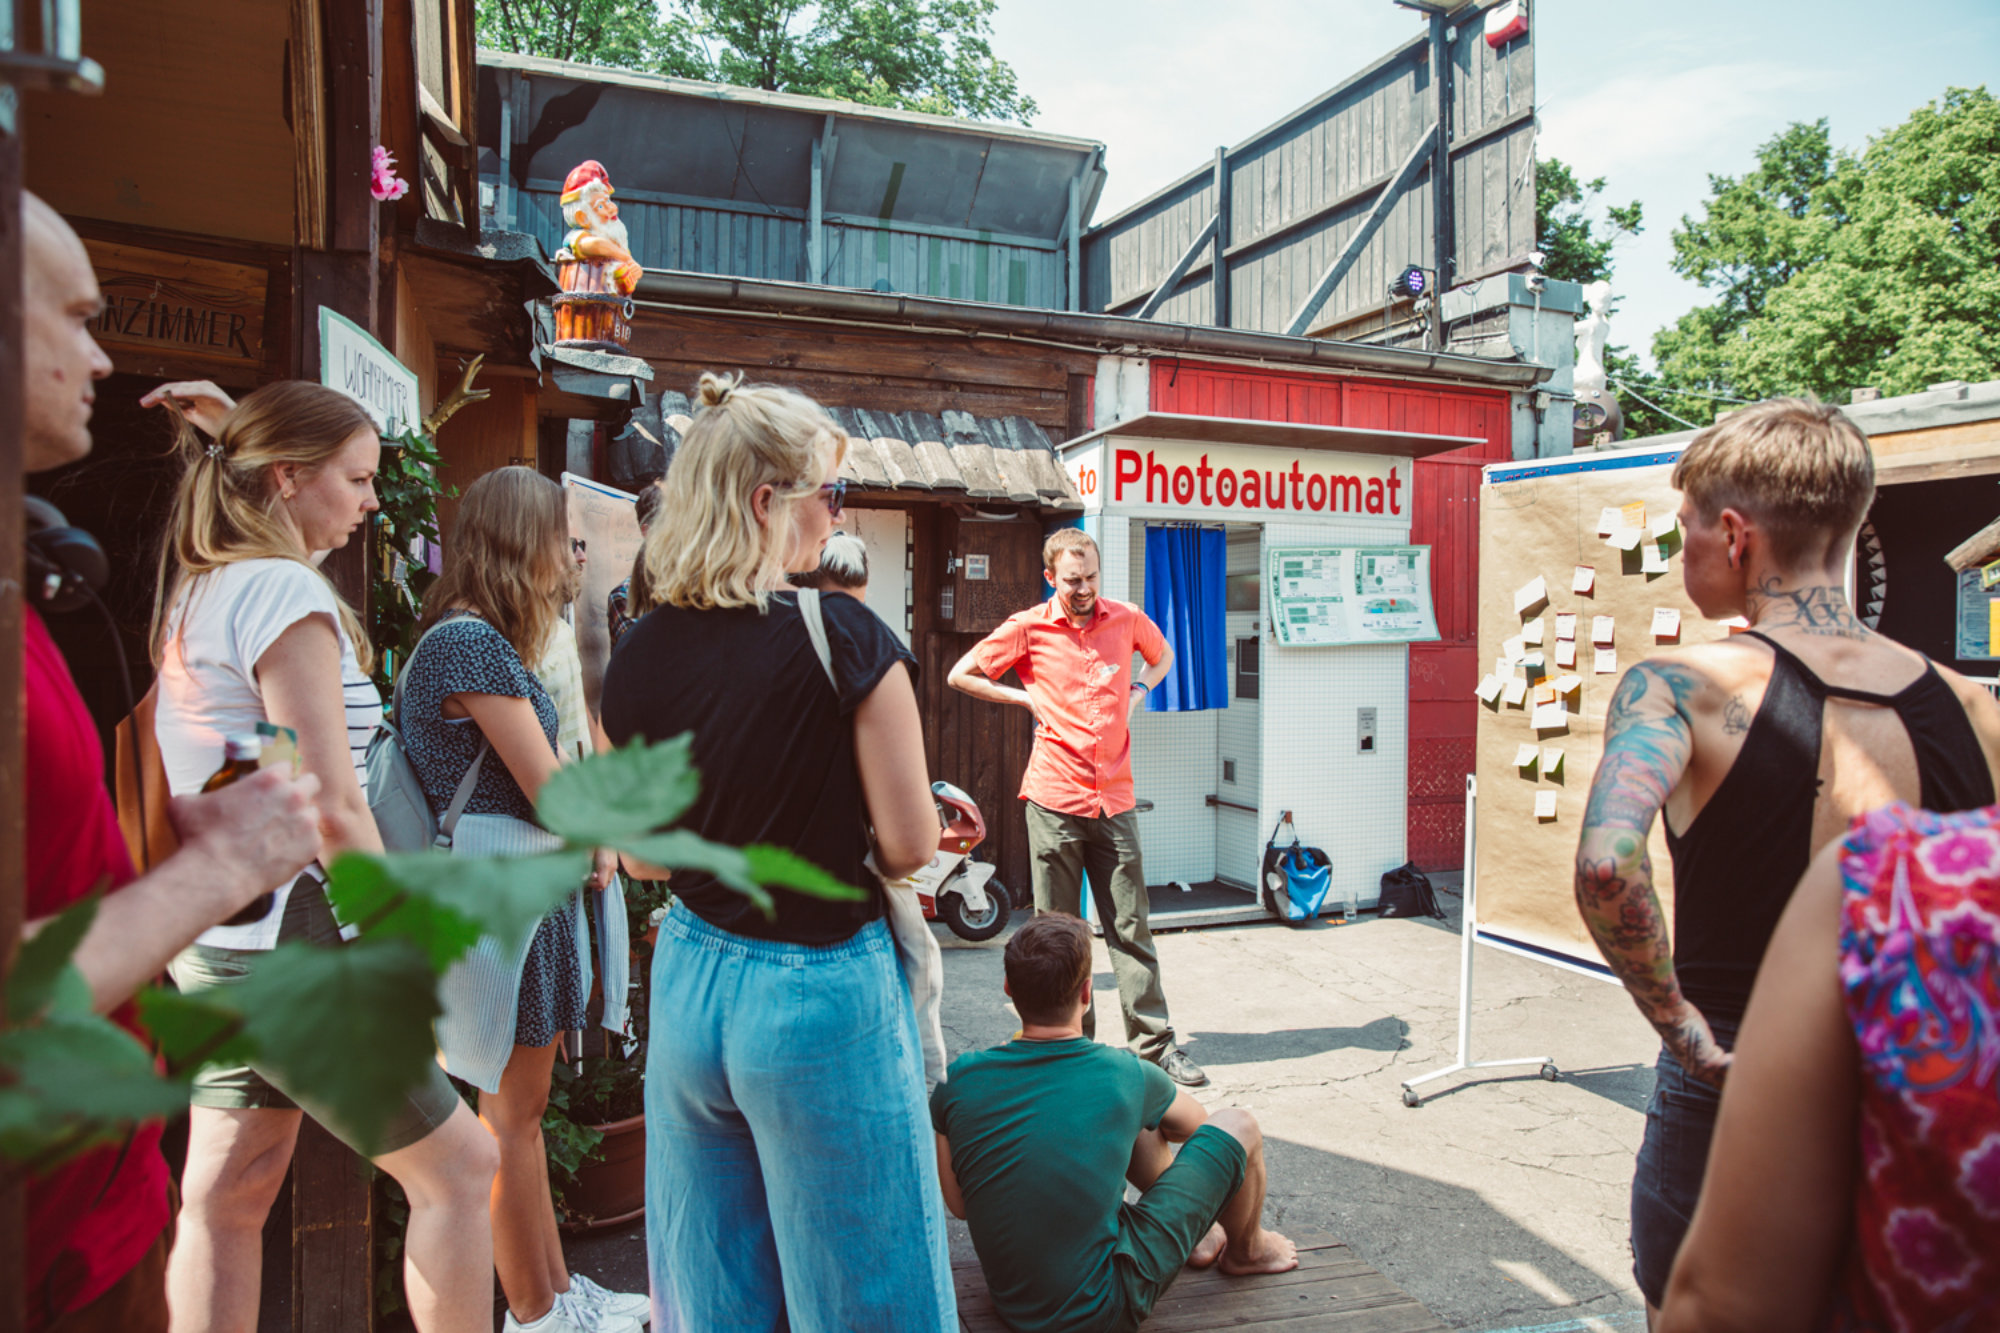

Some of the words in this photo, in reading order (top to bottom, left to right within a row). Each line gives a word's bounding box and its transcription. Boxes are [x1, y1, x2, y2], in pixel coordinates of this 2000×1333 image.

[97, 294, 253, 358] NZIMMER
[1073, 464, 1097, 496] to
[1115, 449, 1401, 516] Photoautomat
